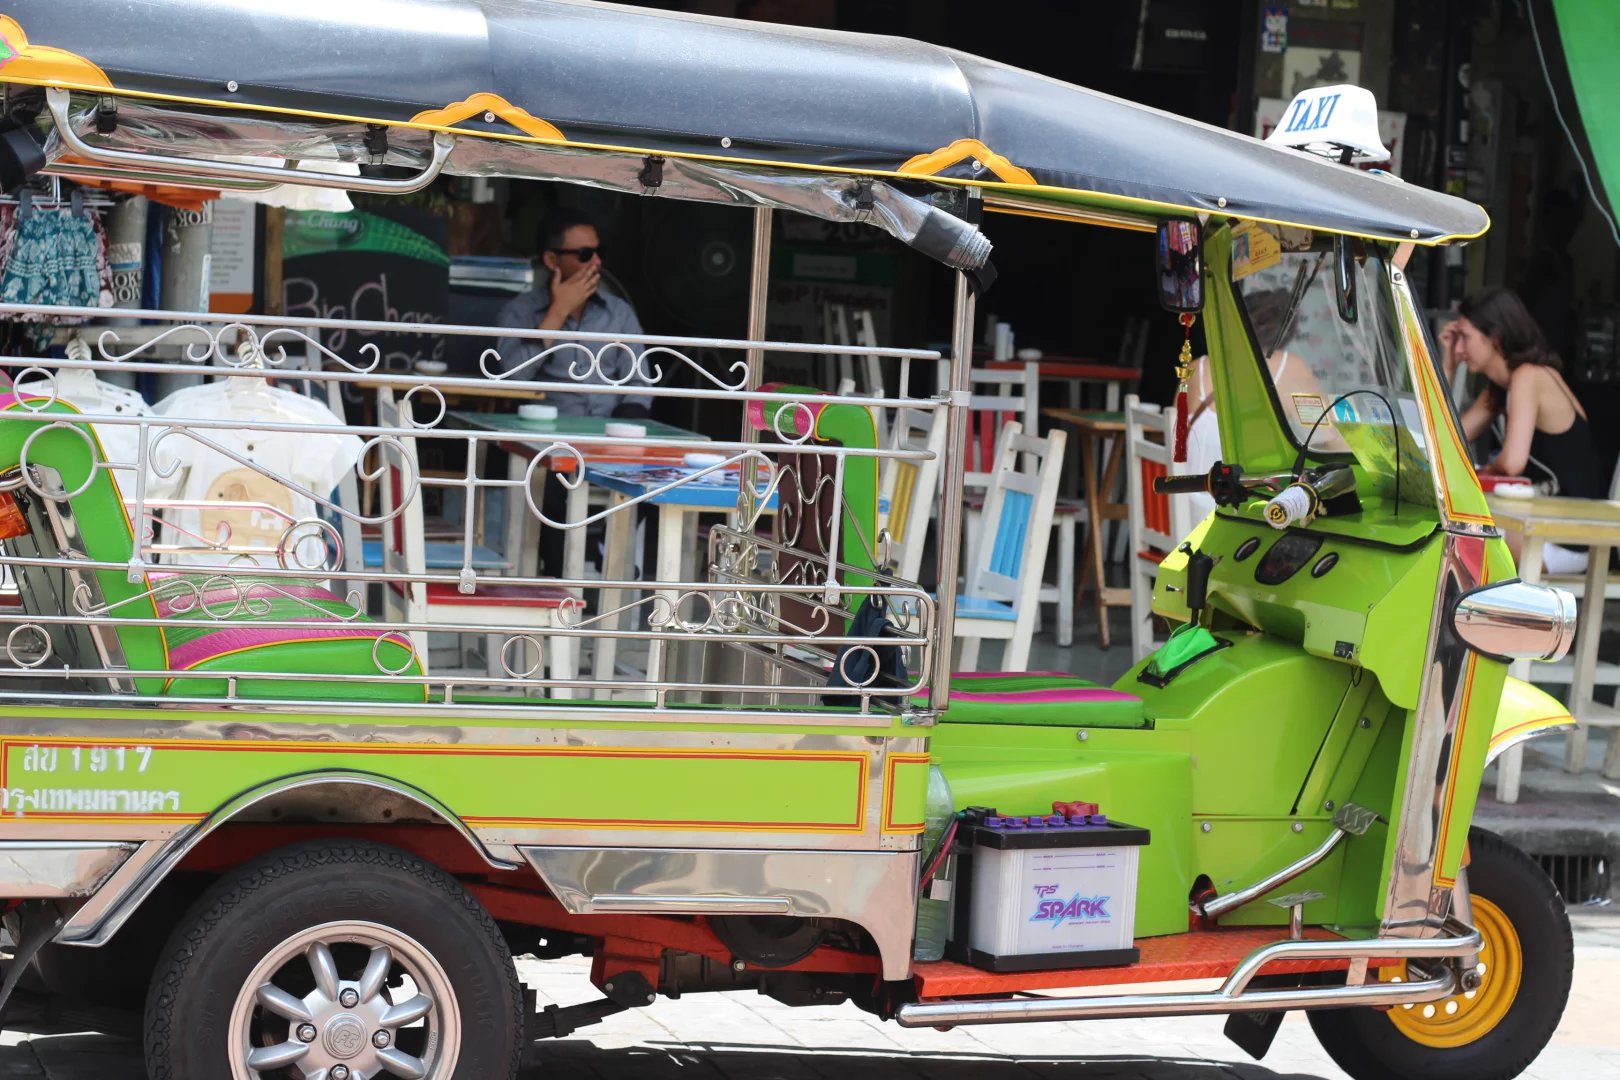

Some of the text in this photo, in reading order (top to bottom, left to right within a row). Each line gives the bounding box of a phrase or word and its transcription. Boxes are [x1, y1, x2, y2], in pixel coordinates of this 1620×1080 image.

[1285, 93, 1341, 132] TAXI
[307, 212, 359, 234] Chang
[283, 277, 348, 352] Big
[71, 746, 152, 772] 1917
[1034, 884, 1059, 898] TPS
[1034, 896, 1107, 920] SPARK
